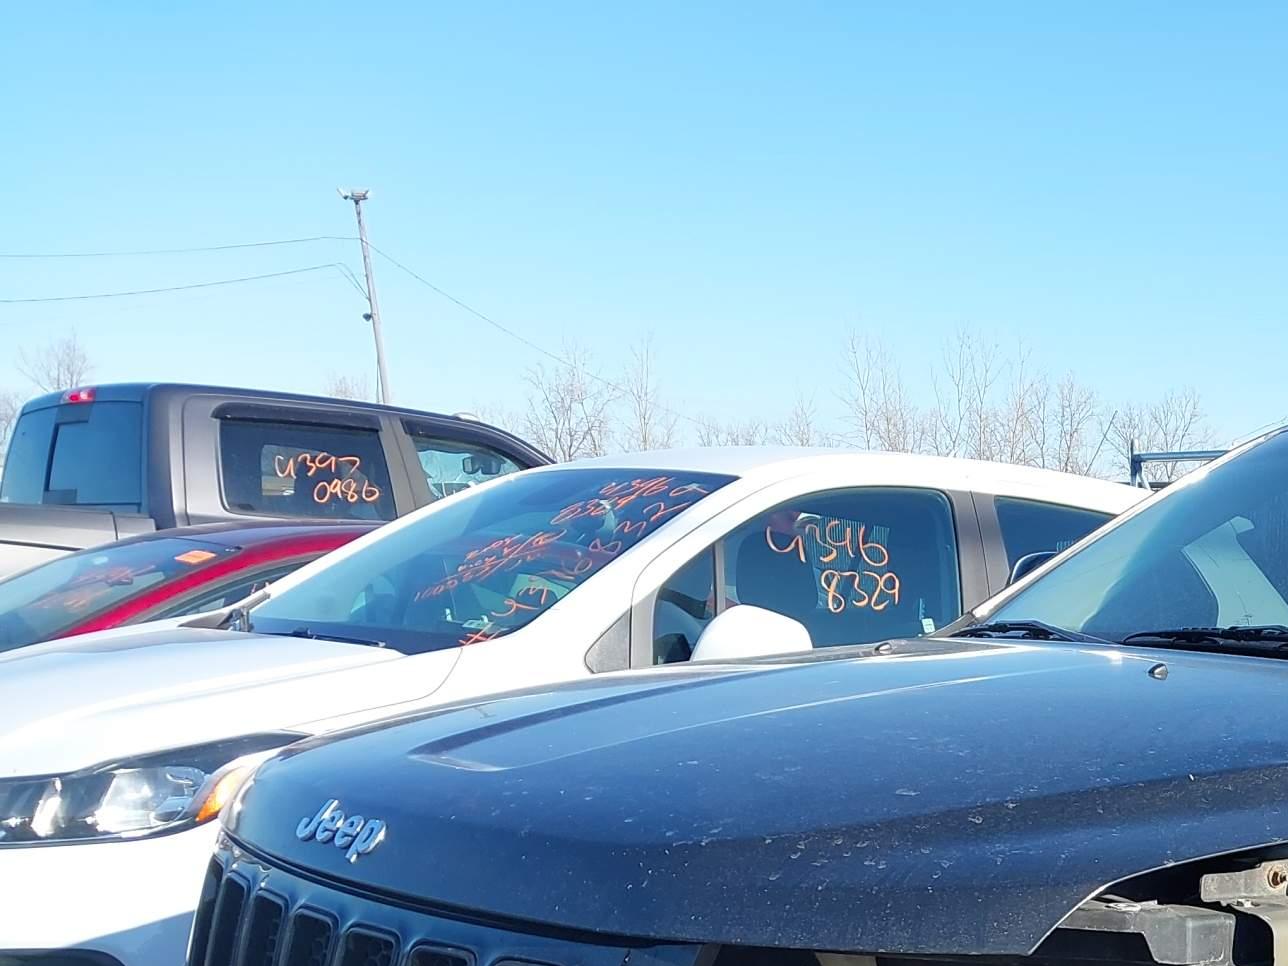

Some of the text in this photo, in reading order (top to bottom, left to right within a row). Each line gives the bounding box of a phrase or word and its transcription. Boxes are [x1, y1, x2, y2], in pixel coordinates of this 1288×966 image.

[313, 478, 380, 503] 0986
[820, 569, 900, 613] 8329
[295, 798, 387, 864] Jeep
